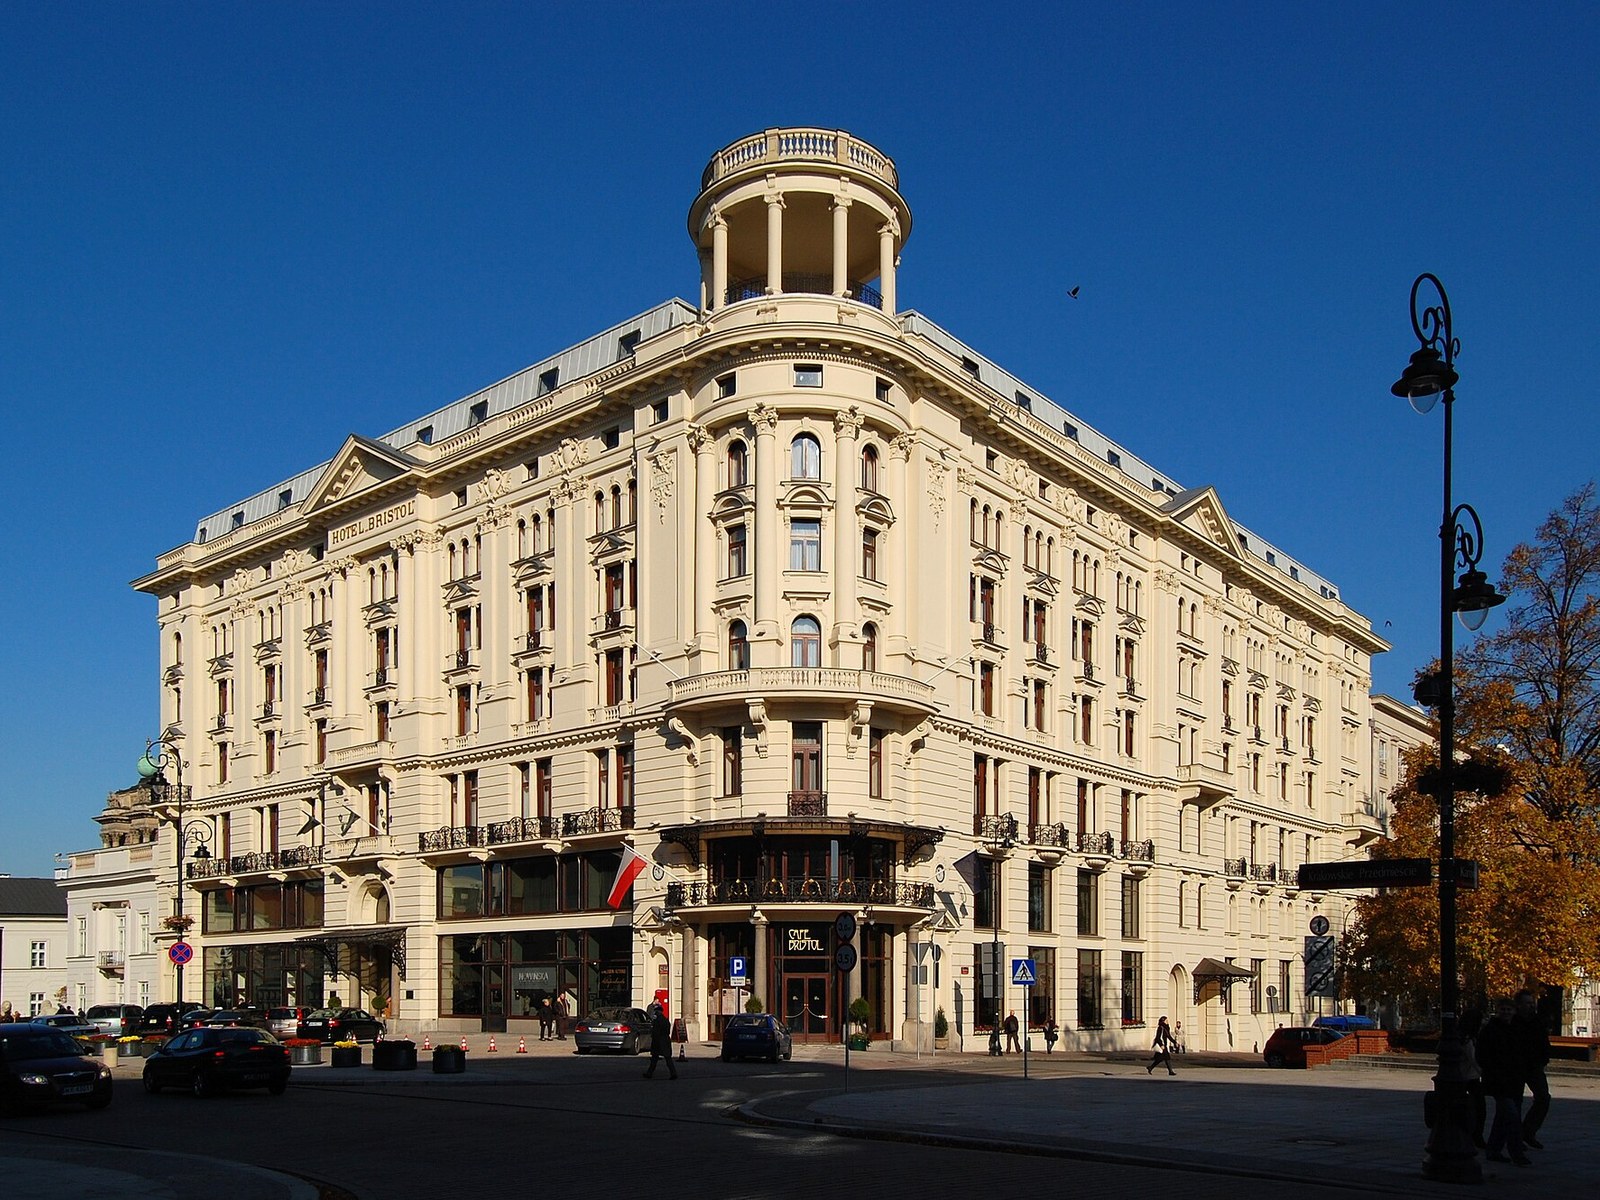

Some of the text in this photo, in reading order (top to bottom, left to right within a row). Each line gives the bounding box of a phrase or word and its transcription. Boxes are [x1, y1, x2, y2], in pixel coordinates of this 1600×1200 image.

[332, 500, 416, 545] HOTEL BRISTOL
[1308, 868, 1354, 881] Krakowskie
[788, 939, 824, 951] BRISTOL
[734, 959, 743, 974] P
